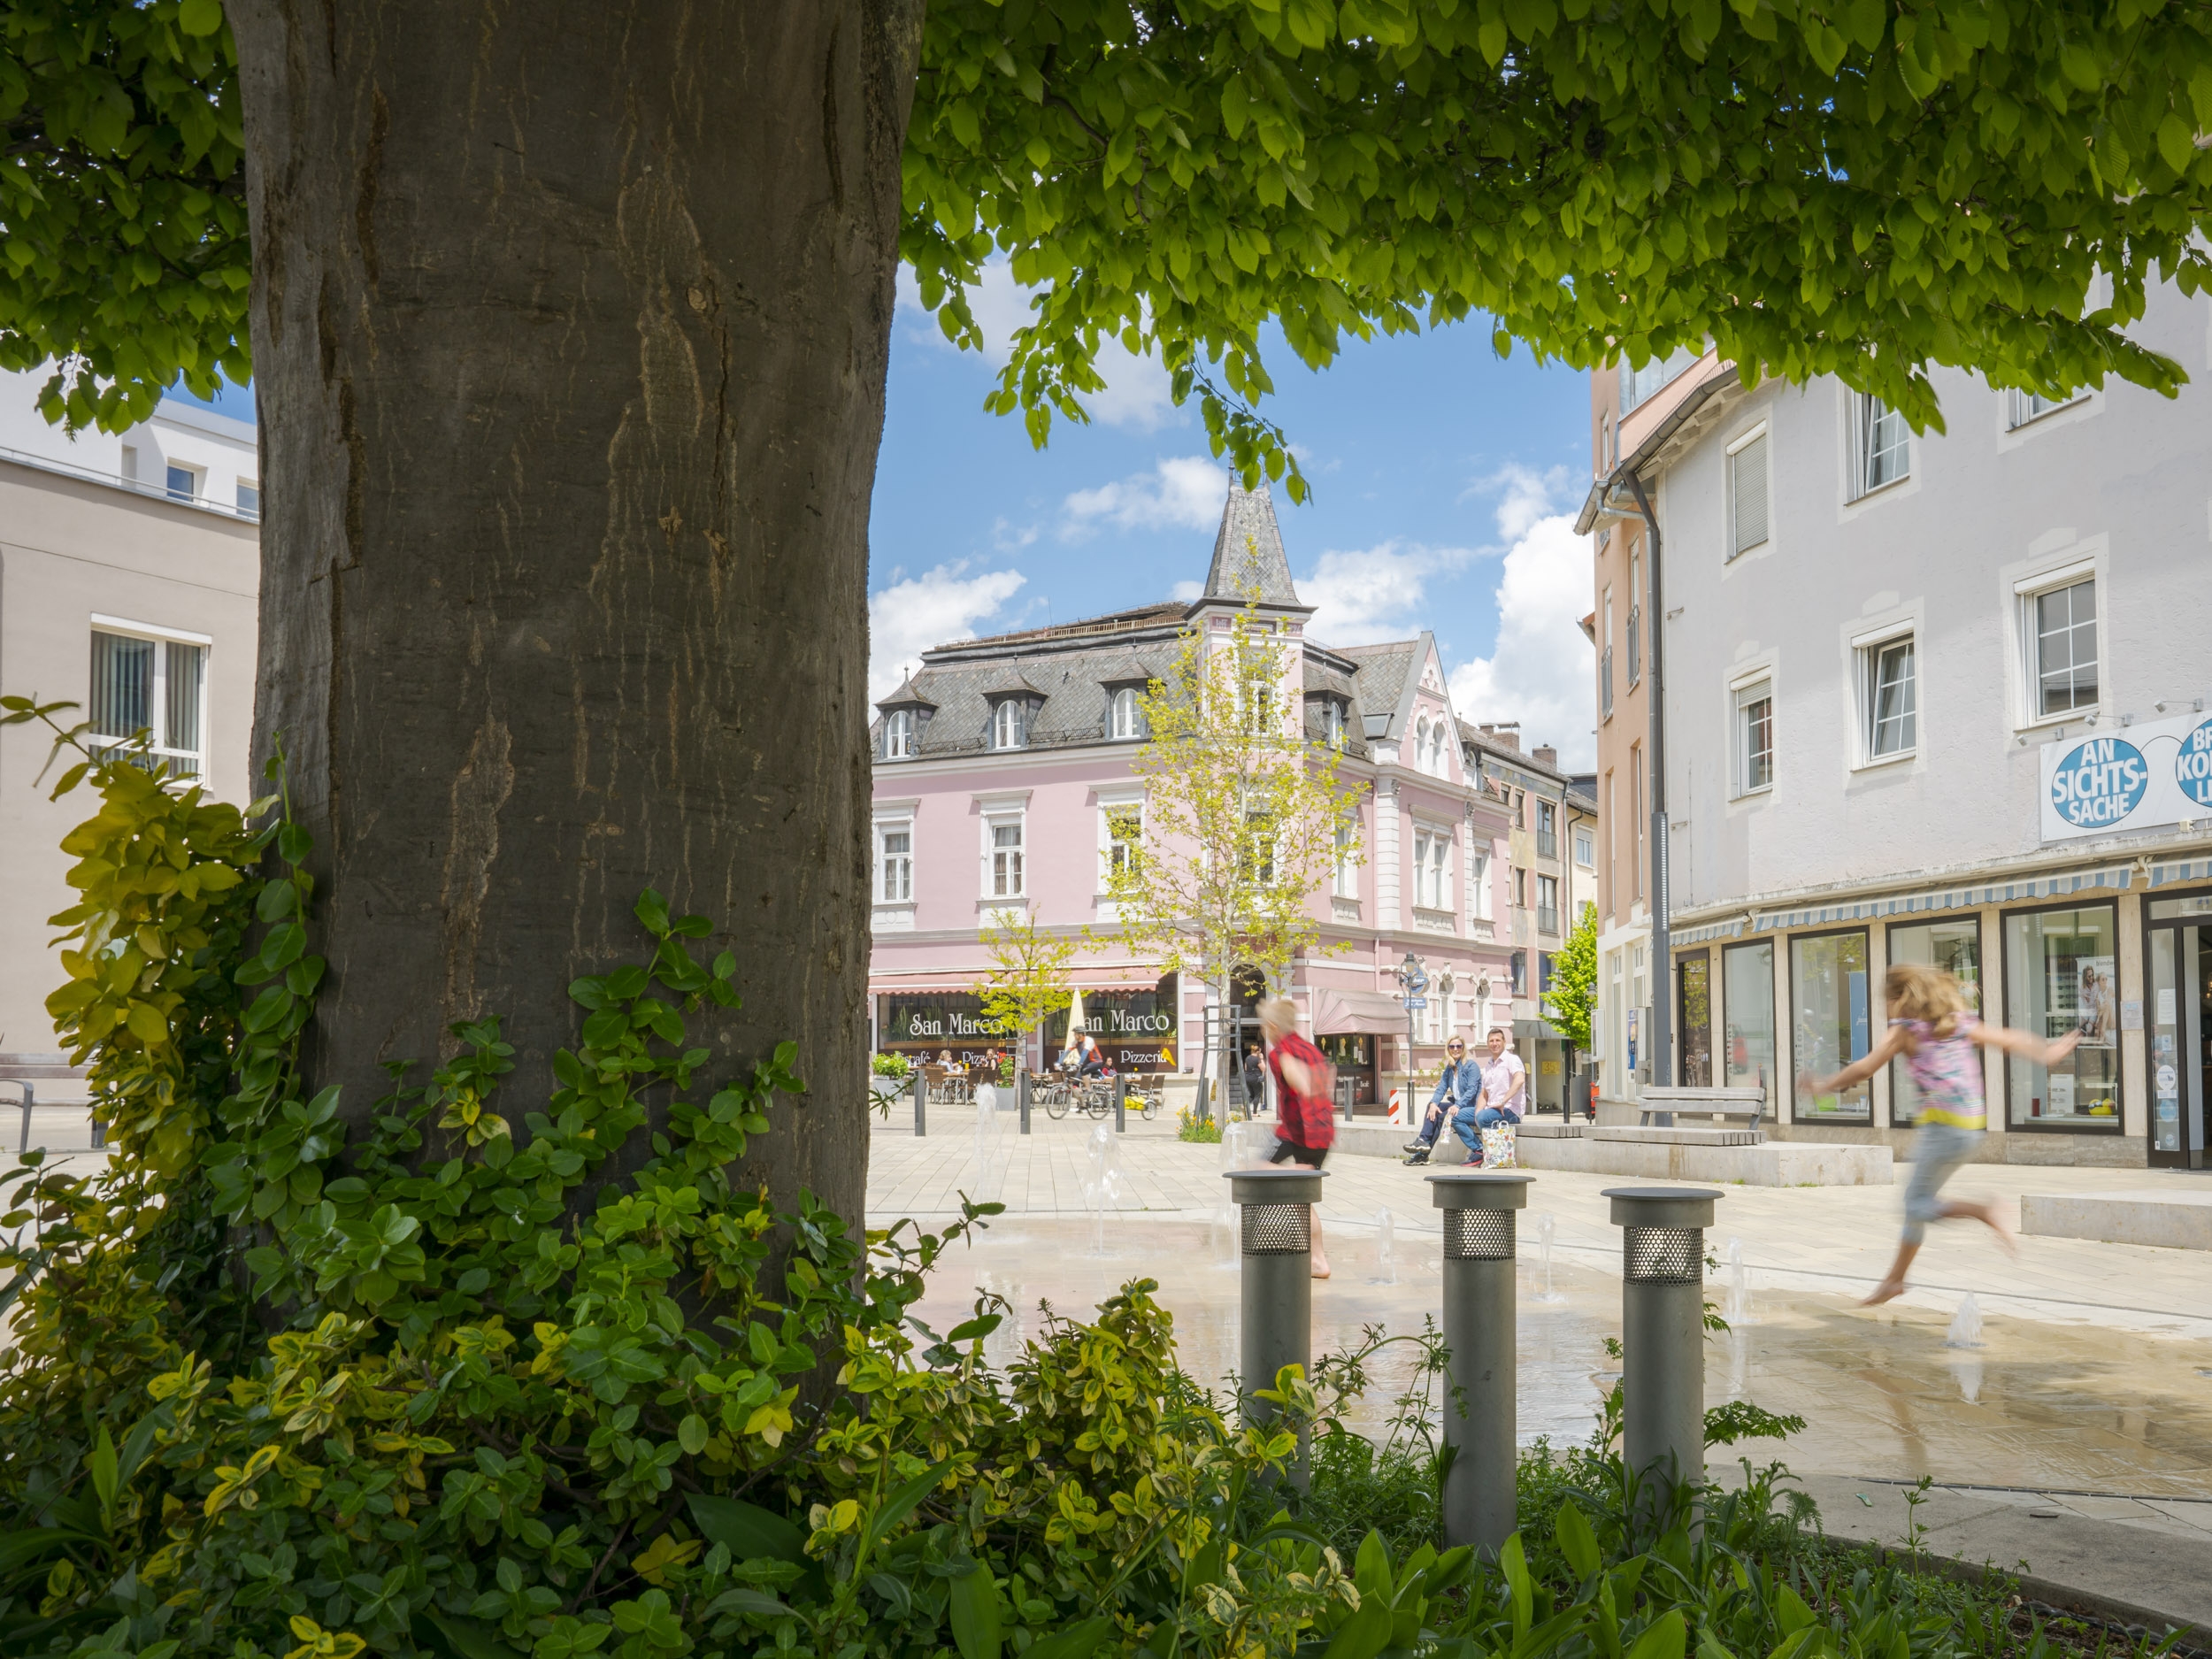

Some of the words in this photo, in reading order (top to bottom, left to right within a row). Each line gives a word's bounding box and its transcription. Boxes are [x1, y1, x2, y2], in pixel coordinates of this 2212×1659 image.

[2080, 739, 2115, 766] AN
[2177, 750, 2212, 781] KO
[2052, 757, 2147, 803] SICHTS-
[2069, 793, 2130, 824] SACHE
[910, 1013, 942, 1036] San
[1085, 1016, 1103, 1032] an
[1110, 1010, 1170, 1032] Marco
